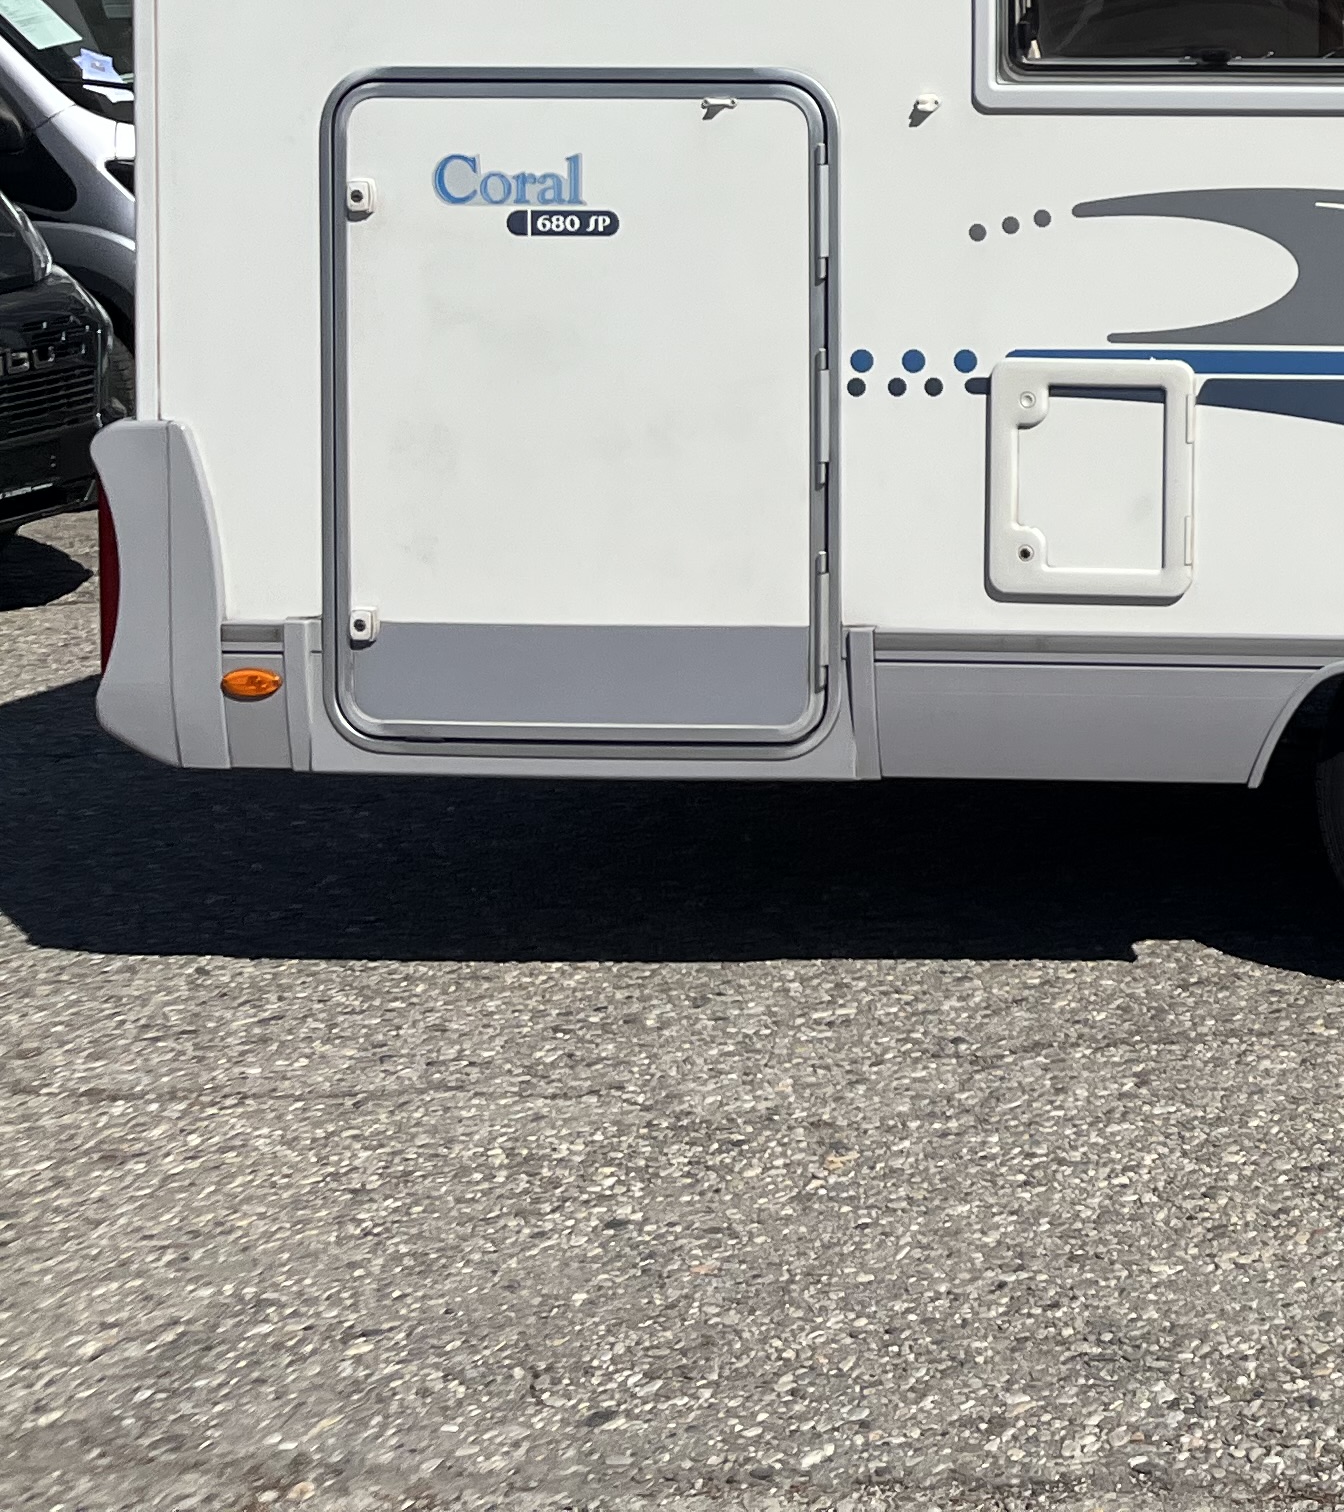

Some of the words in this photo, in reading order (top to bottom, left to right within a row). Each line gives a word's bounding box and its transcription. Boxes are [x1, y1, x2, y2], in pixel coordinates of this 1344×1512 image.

[433, 152, 586, 206] Coral
[536, 215, 581, 232] 680
[586, 215, 611, 232] SP
